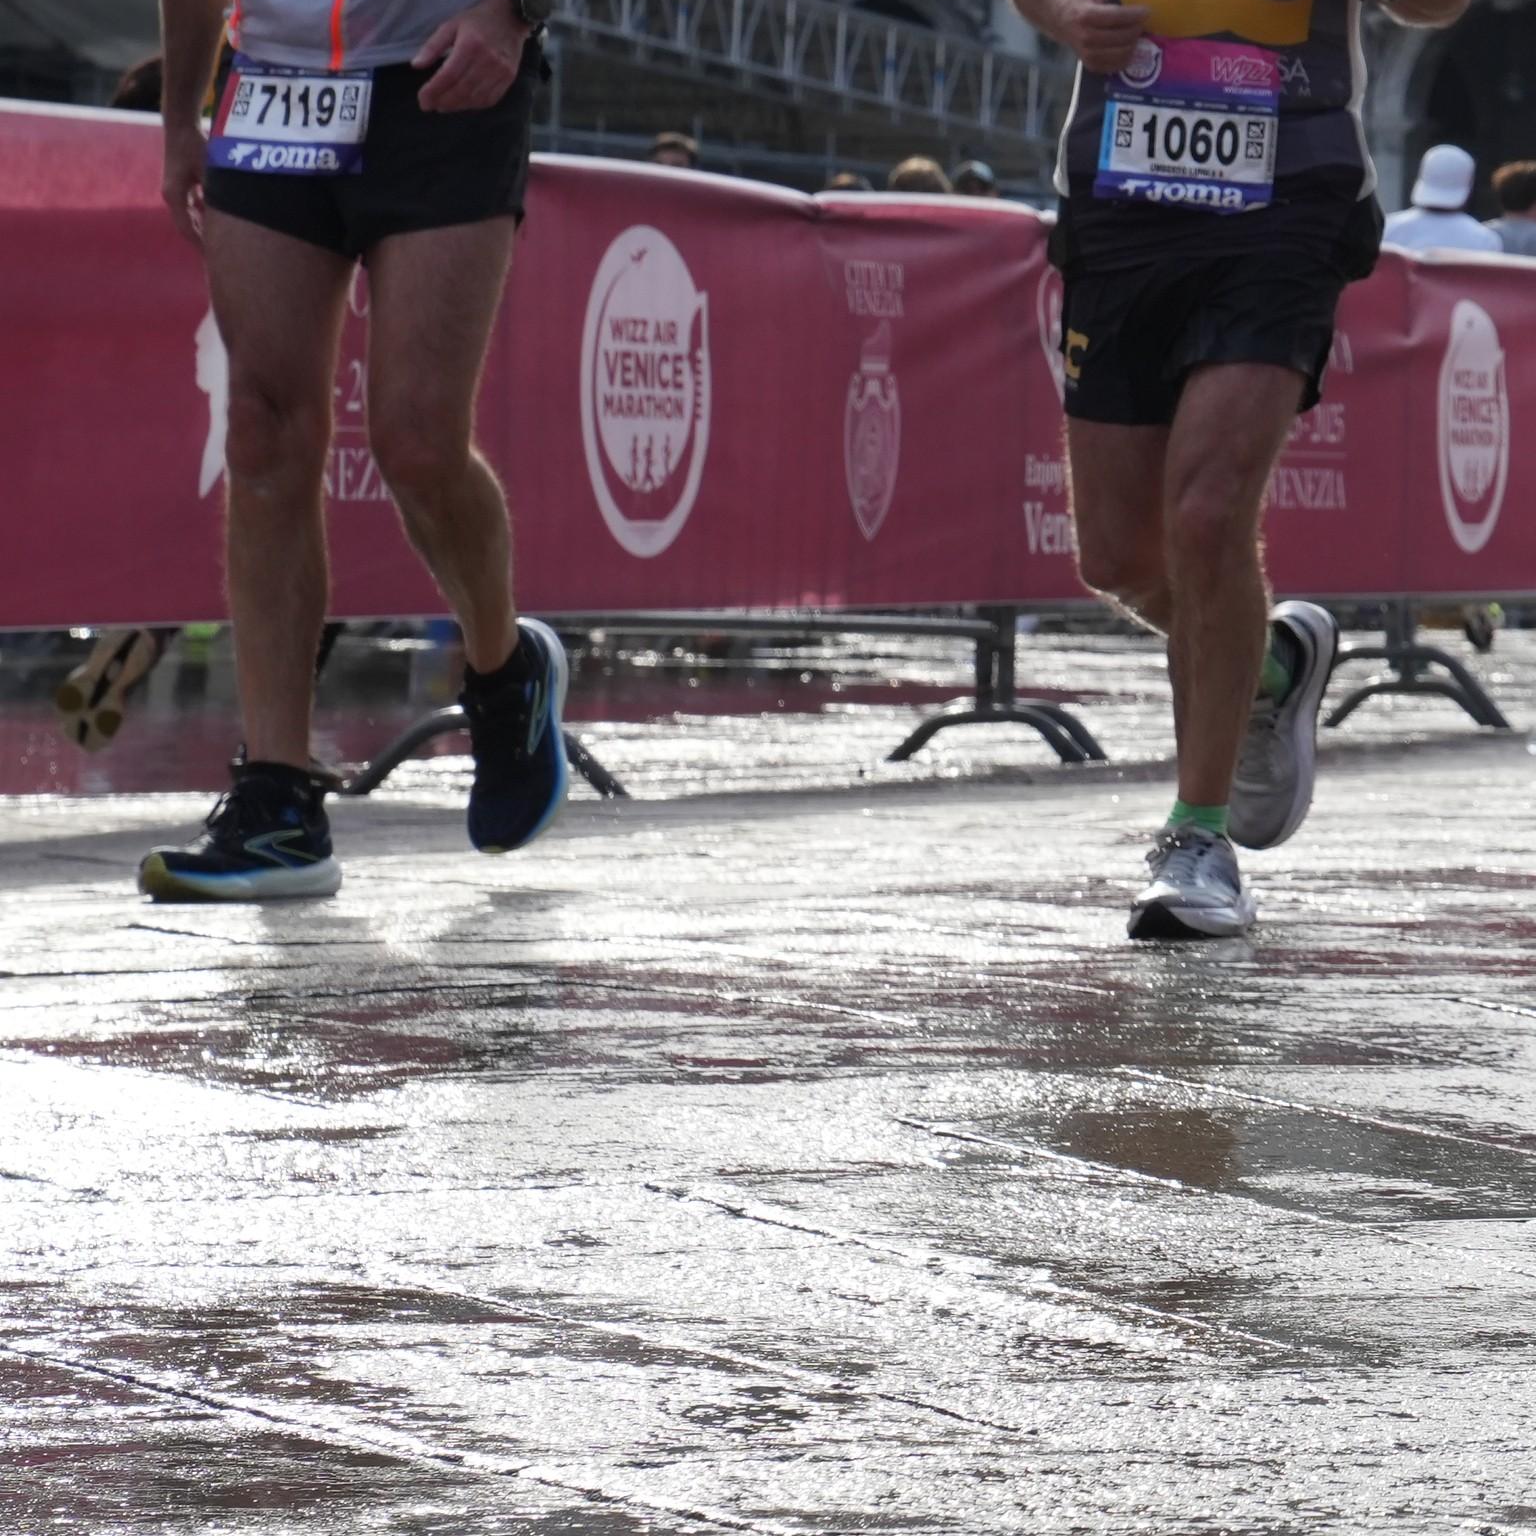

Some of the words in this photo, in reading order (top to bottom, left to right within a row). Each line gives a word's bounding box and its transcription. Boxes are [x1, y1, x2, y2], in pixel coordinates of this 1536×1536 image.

[256, 83, 337, 127] 7119
[1143, 113, 1239, 165] 1060
[609, 318, 649, 345] WIZZ
[653, 319, 678, 346] AIR
[603, 350, 684, 390] VENICE
[603, 393, 685, 420] MARATHON
